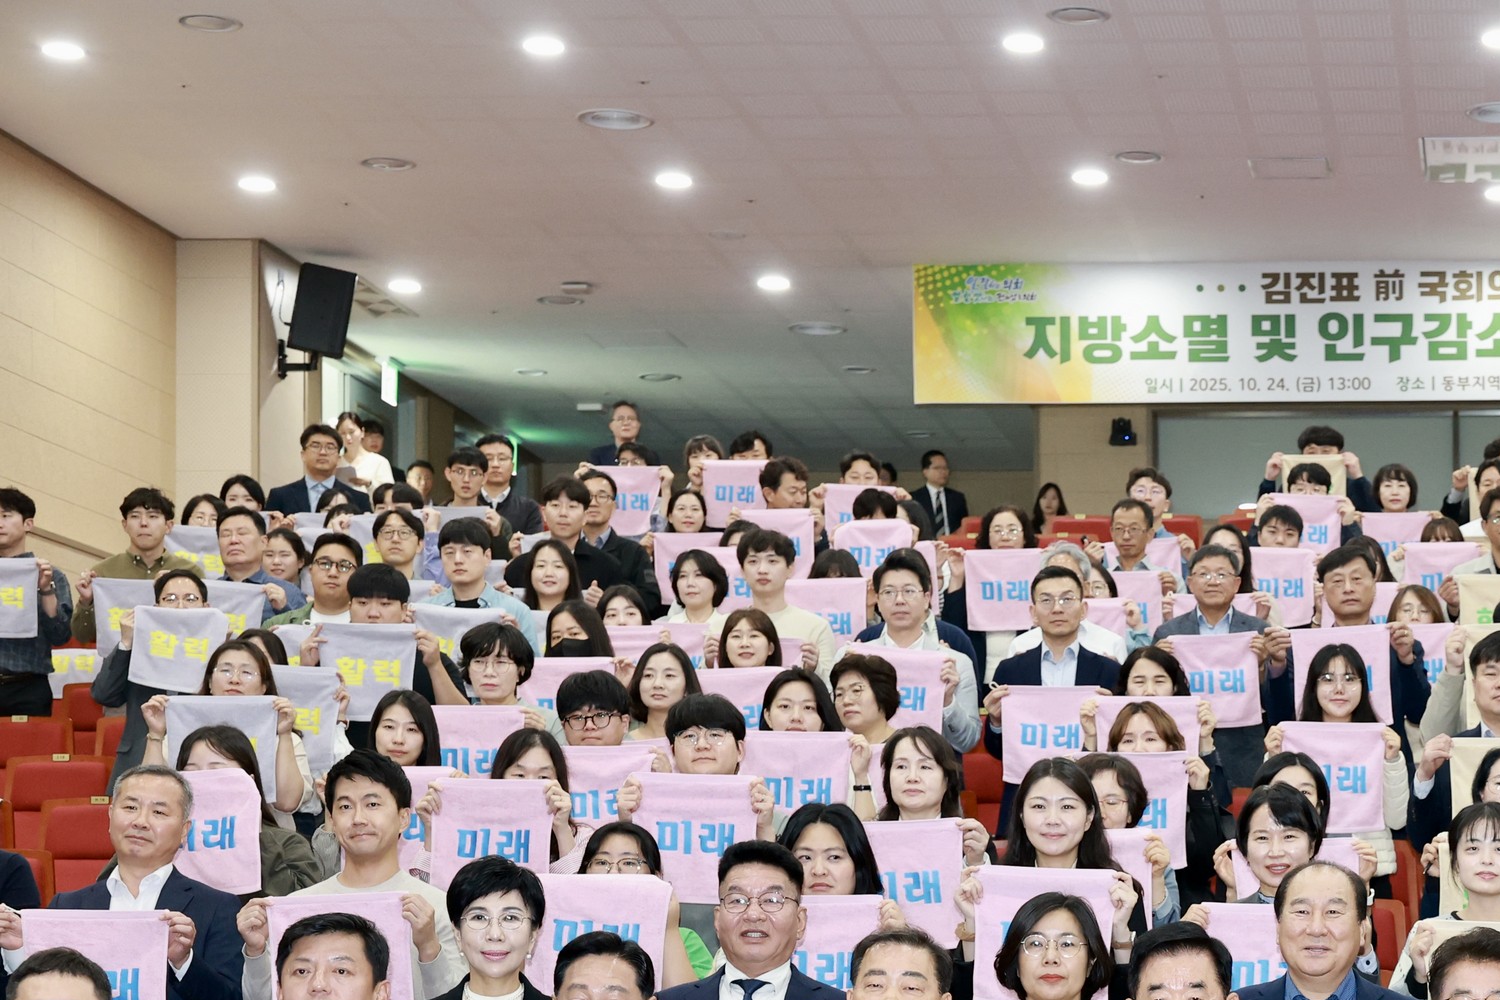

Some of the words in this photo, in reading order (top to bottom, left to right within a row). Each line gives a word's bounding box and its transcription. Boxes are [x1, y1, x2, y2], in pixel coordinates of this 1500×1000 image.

[1260, 271, 1361, 304] 김진표
[1373, 269, 1405, 302] 前
[1023, 313, 1231, 365] 지방소멸
[1250, 312, 1298, 363] 및
[1144, 378, 1173, 394] 일시
[1189, 378, 1232, 392] 2025.
[1239, 378, 1261, 391] 10.
[1266, 377, 1290, 391] 24.
[1296, 376, 1321, 393] (금)
[1328, 376, 1372, 391] 13:00
[1396, 375, 1425, 392] 장소
[714, 485, 756, 504] 미래
[981, 581, 1030, 603] 미래
[1258, 578, 1305, 599] 미래
[149, 629, 211, 664] 활력
[1189, 669, 1248, 696] 미래
[898, 686, 928, 713] 래
[294, 706, 322, 736] 력
[1020, 722, 1081, 751] 미래
[764, 775, 834, 811] 미래
[457, 828, 533, 865] 미래
[655, 819, 737, 859] 미래
